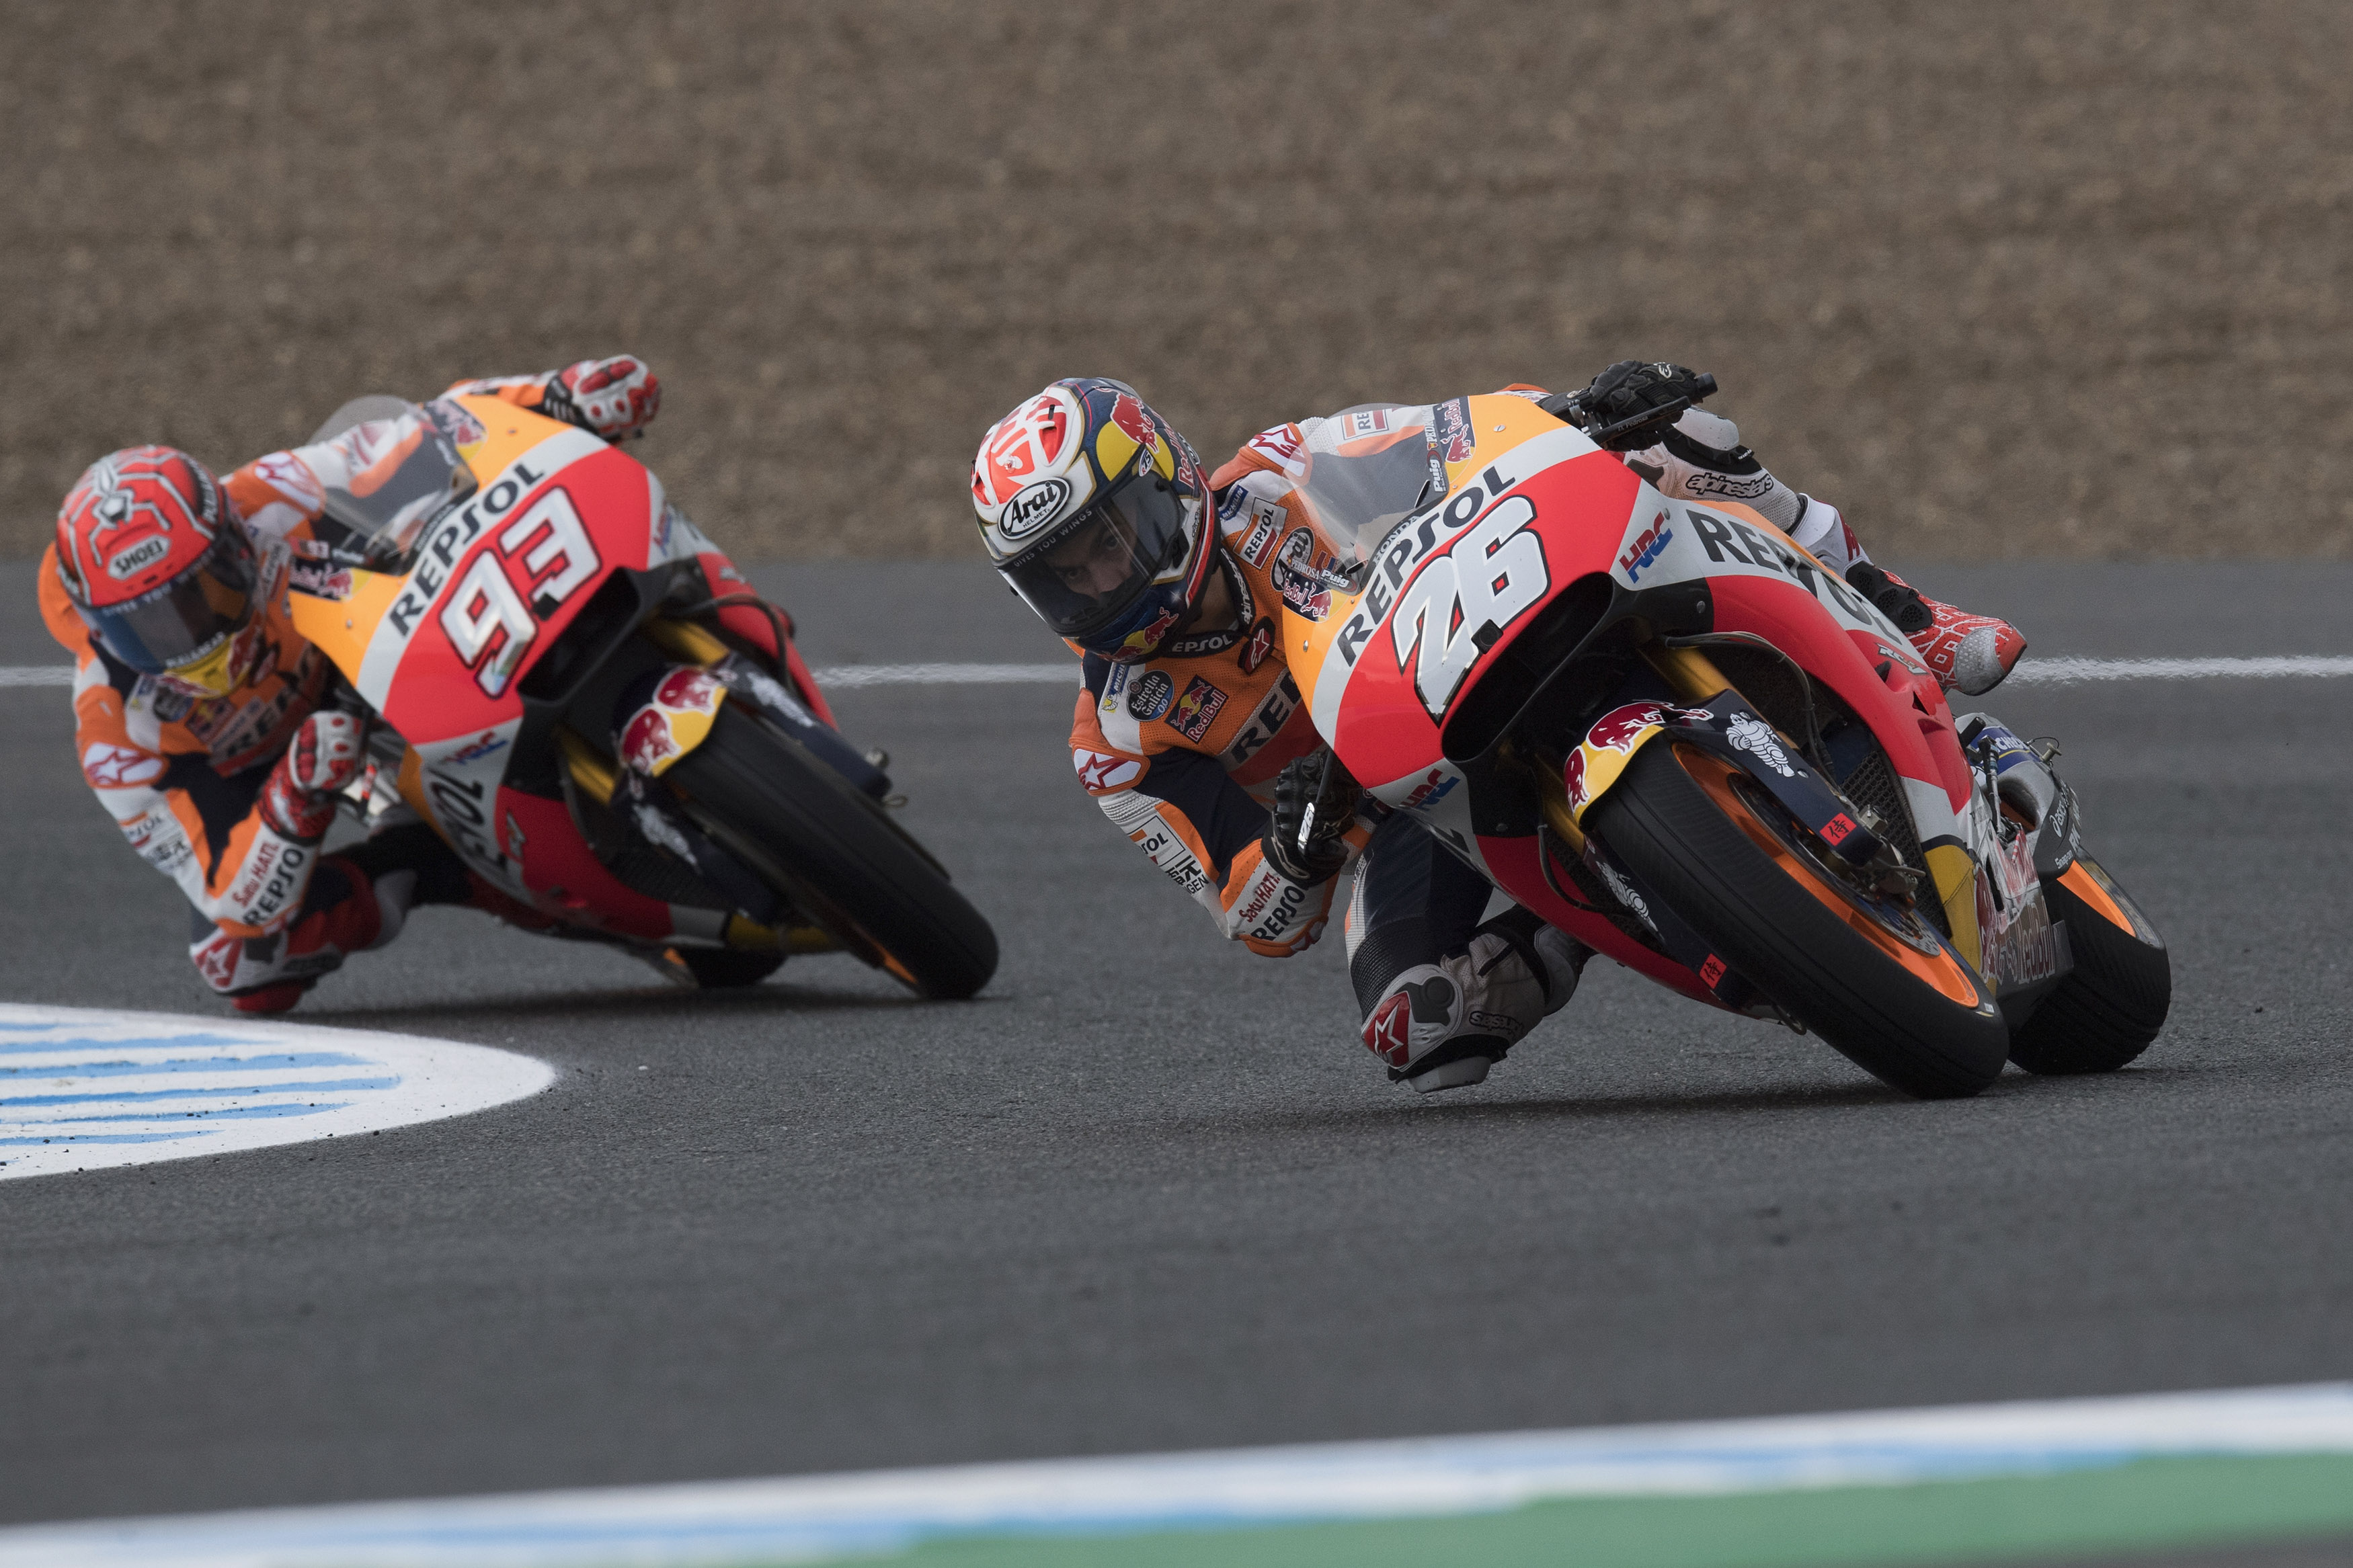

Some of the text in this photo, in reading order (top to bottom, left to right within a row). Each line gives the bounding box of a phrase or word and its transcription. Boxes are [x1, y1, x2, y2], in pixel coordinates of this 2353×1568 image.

[1430, 460, 1443, 492] Puig
[1685, 472, 1773, 499] alpinestars
[1007, 481, 1058, 534] Arai
[1023, 509, 1048, 529] HELMET
[389, 463, 544, 636] REPSOL
[1013, 508, 1092, 567] GIVES YOU WINGS
[1244, 508, 1274, 560] REPSOL
[1373, 515, 1421, 565] HONDA
[115, 539, 163, 573] SHOEI
[1291, 559, 1320, 580] PEDROSA
[1335, 466, 1515, 666] REPSOL
[439, 485, 603, 700] 93
[1321, 569, 1350, 588] Puig
[1391, 494, 1551, 729] 26
[1172, 634, 1233, 653] EPSOL
[1113, 664, 1126, 692] MICH
[1131, 674, 1160, 712] Estrella
[1141, 683, 1169, 716] Galicia
[1828, 819, 1849, 839] 侍
[2055, 850, 2073, 869] Snap-on
[1183, 874, 1209, 895] GEN
[1250, 884, 1310, 941] REPSO
[1704, 962, 1722, 982] 侍
